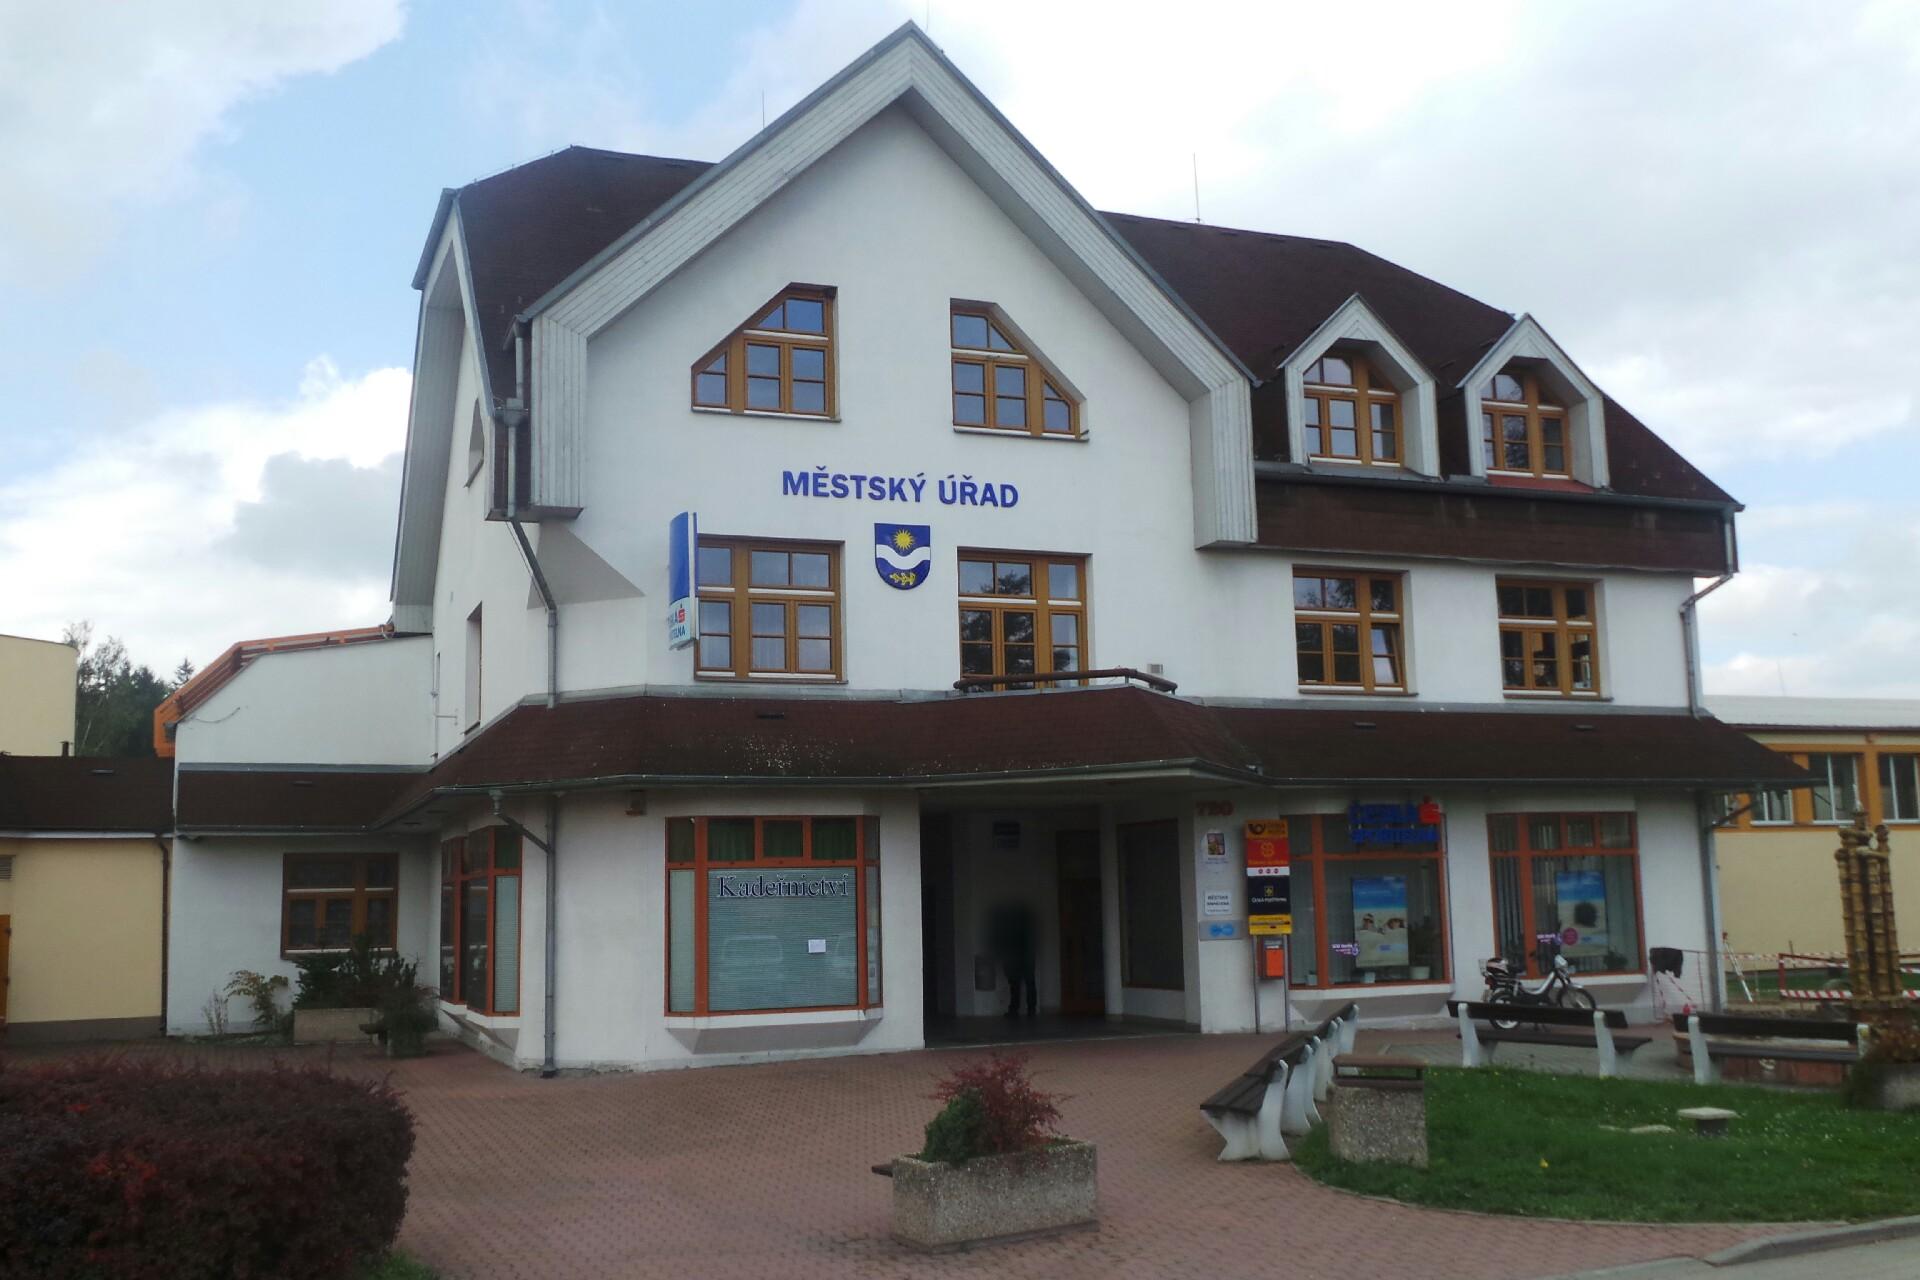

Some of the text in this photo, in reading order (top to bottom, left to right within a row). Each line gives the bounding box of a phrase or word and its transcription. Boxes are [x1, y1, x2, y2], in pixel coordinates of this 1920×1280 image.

[782, 465, 1019, 508] MĚSTSKÝ ÚŘAD
[717, 873, 849, 898] Kadeřnictví
